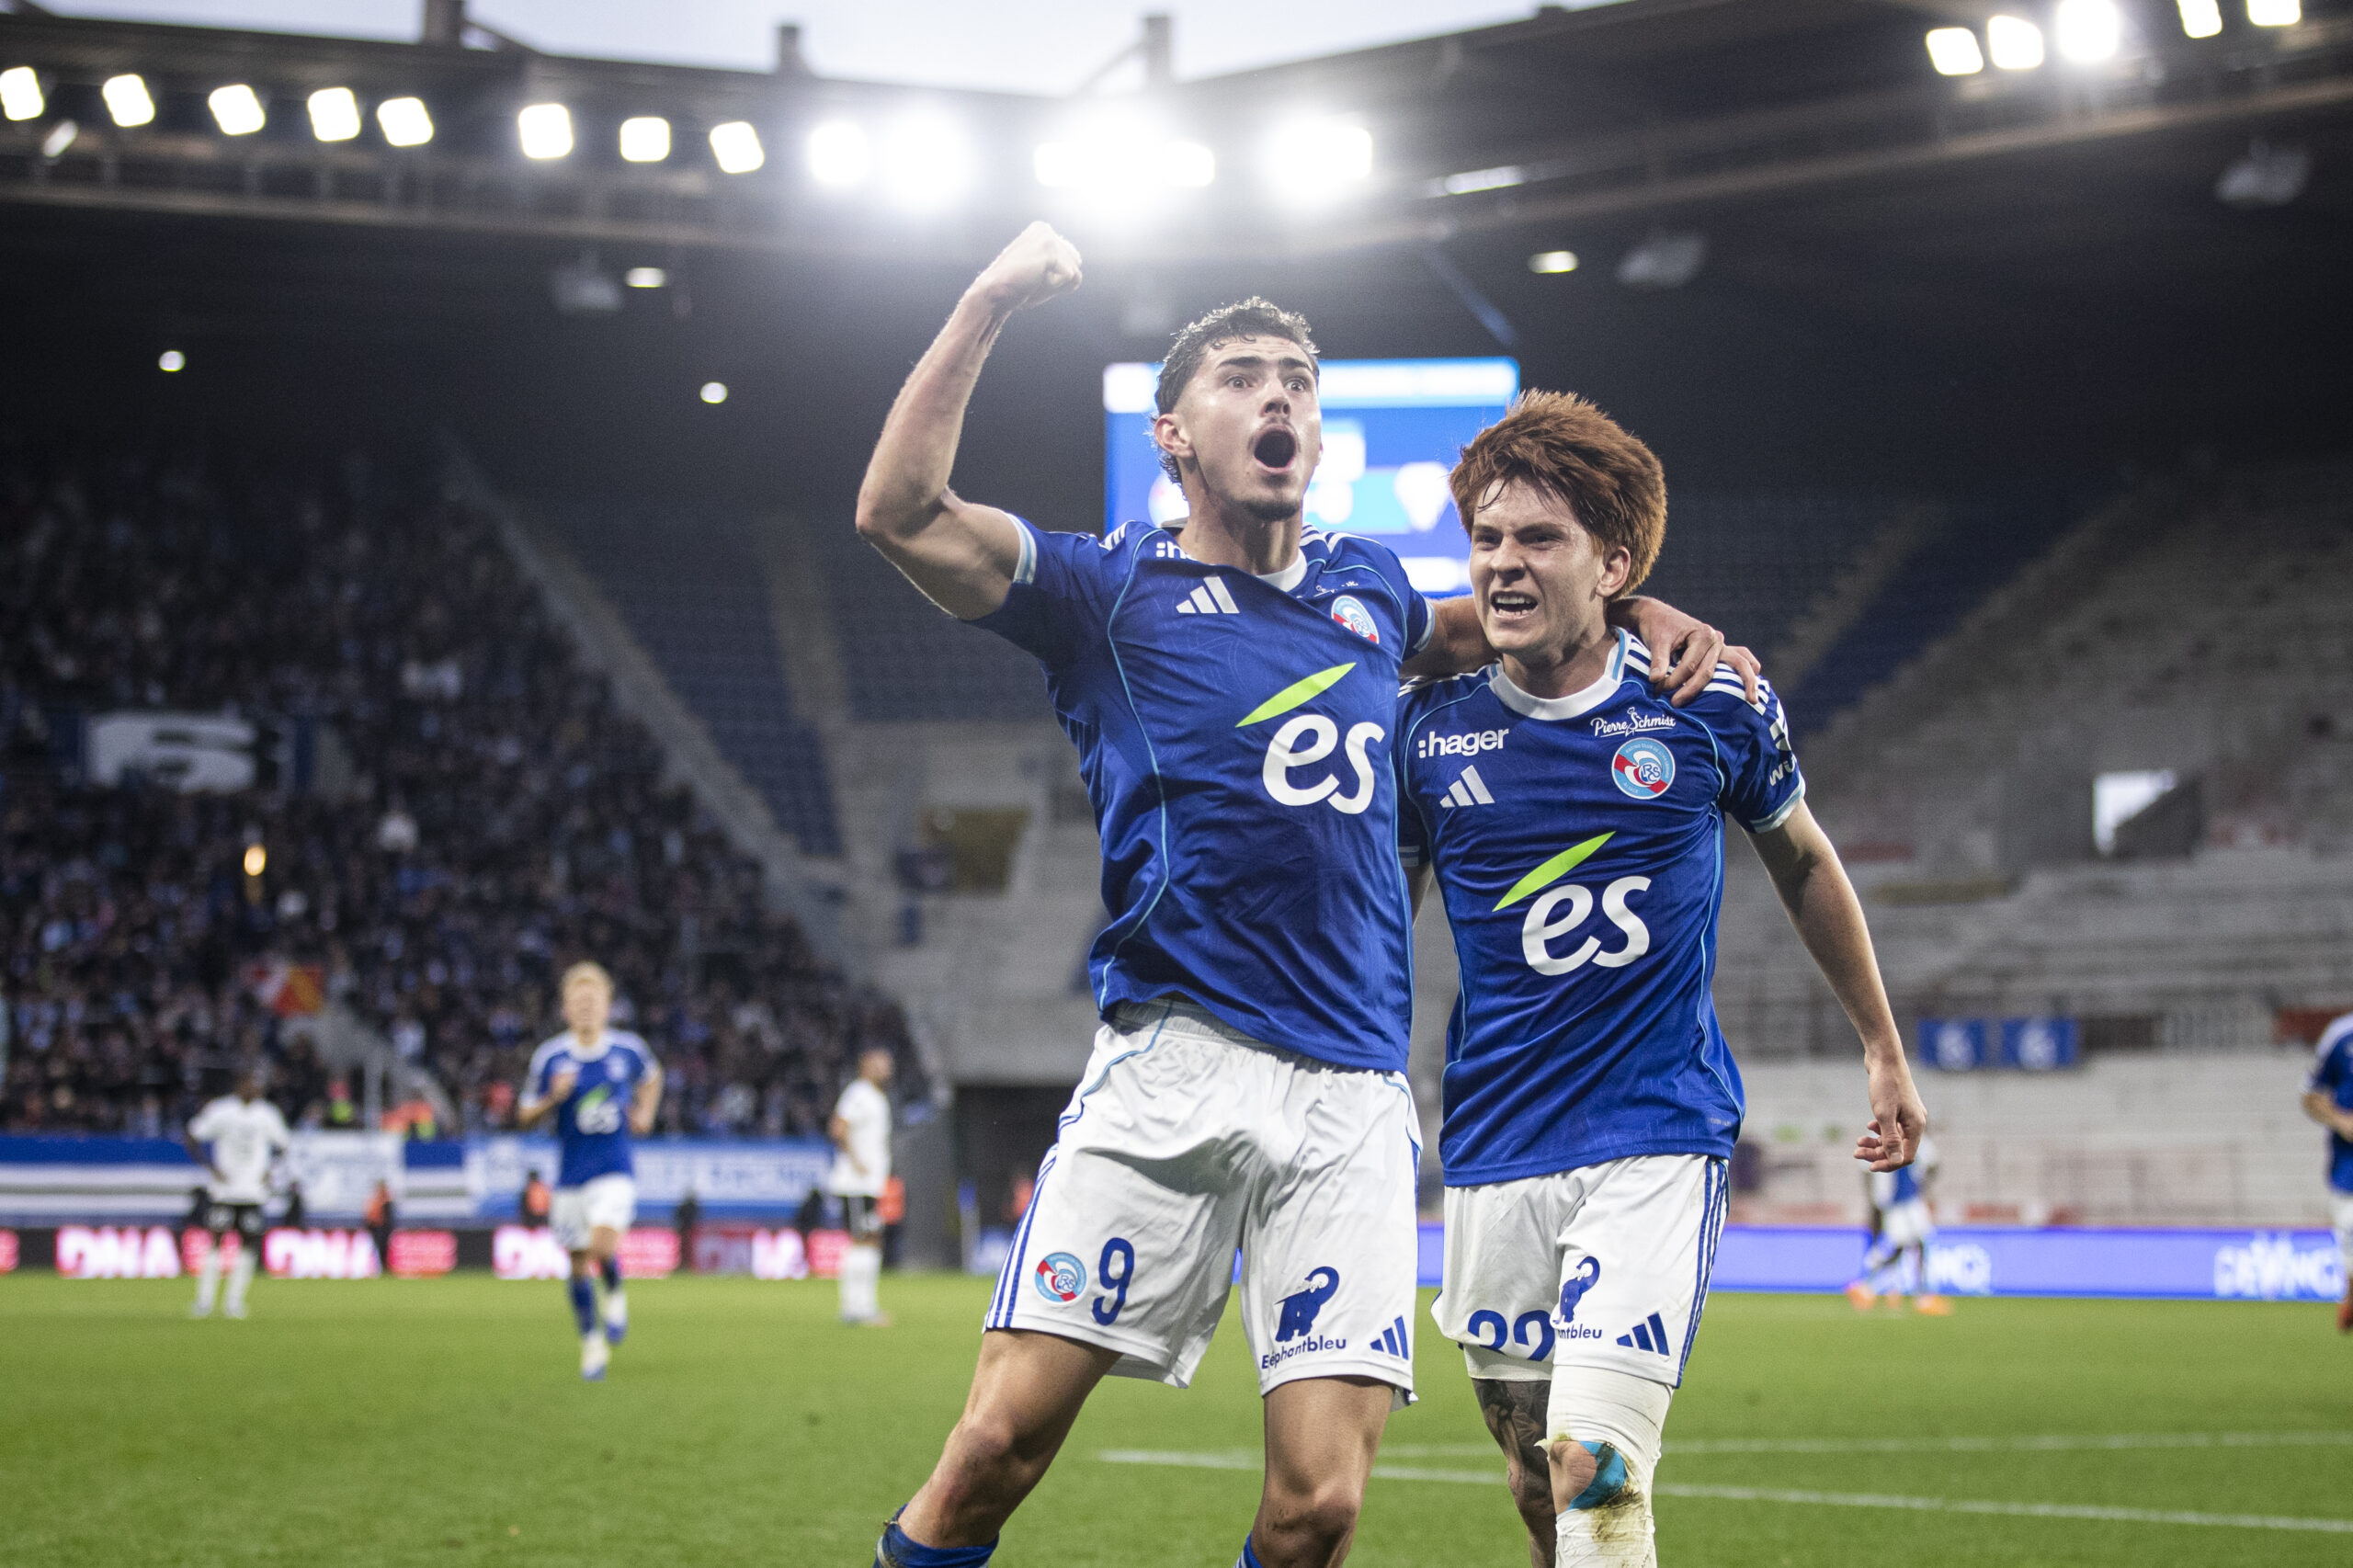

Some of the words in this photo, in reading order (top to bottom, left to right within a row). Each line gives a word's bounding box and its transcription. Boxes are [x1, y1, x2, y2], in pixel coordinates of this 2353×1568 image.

[1262, 713, 1385, 815] es
[1590, 717, 1628, 737] Pierre
[1626, 708, 1677, 735] Schmidt
[1522, 876, 1652, 977] es
[1092, 1237, 1135, 1326] 9
